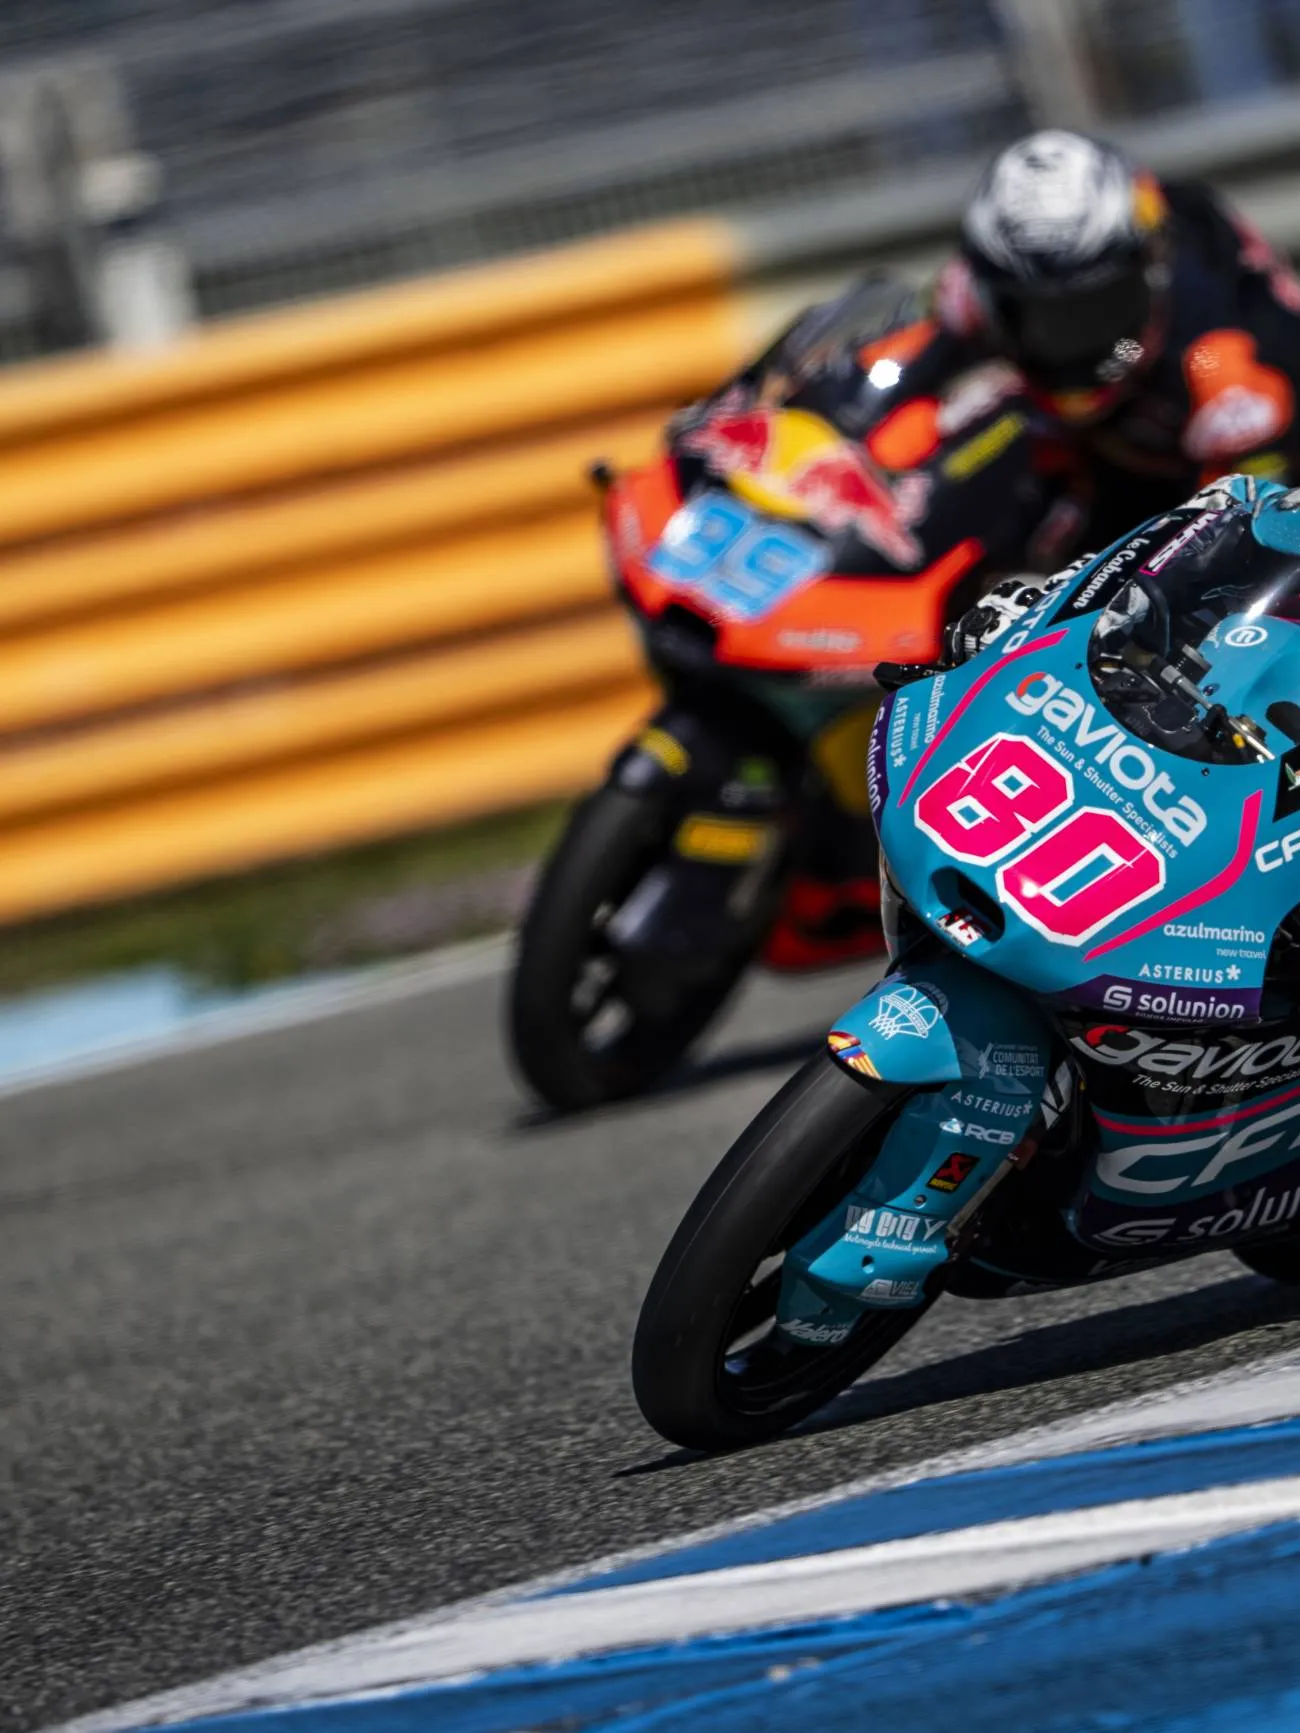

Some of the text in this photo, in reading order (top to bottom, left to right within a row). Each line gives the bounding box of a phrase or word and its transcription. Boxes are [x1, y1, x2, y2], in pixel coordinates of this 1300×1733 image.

[1073, 550, 1136, 609] Cabanon
[1004, 671, 1207, 847] gaviota
[1036, 725, 1178, 859] The Sun & Shutter Specialists
[914, 733, 1166, 946] 80
[1163, 923, 1265, 943] azulmarino
[1216, 948, 1267, 960] new travel
[1137, 992, 1245, 1019] solunion
[993, 1051, 1039, 1064] COMUNITAT
[995, 1064, 1044, 1077] DE L'ESPORT
[1131, 1073, 1160, 1088] The
[1160, 1081, 1191, 1094] Sun
[1192, 1084, 1207, 1095] &
[1205, 1080, 1256, 1095] Shutter
[964, 1123, 1016, 1145] RCB
